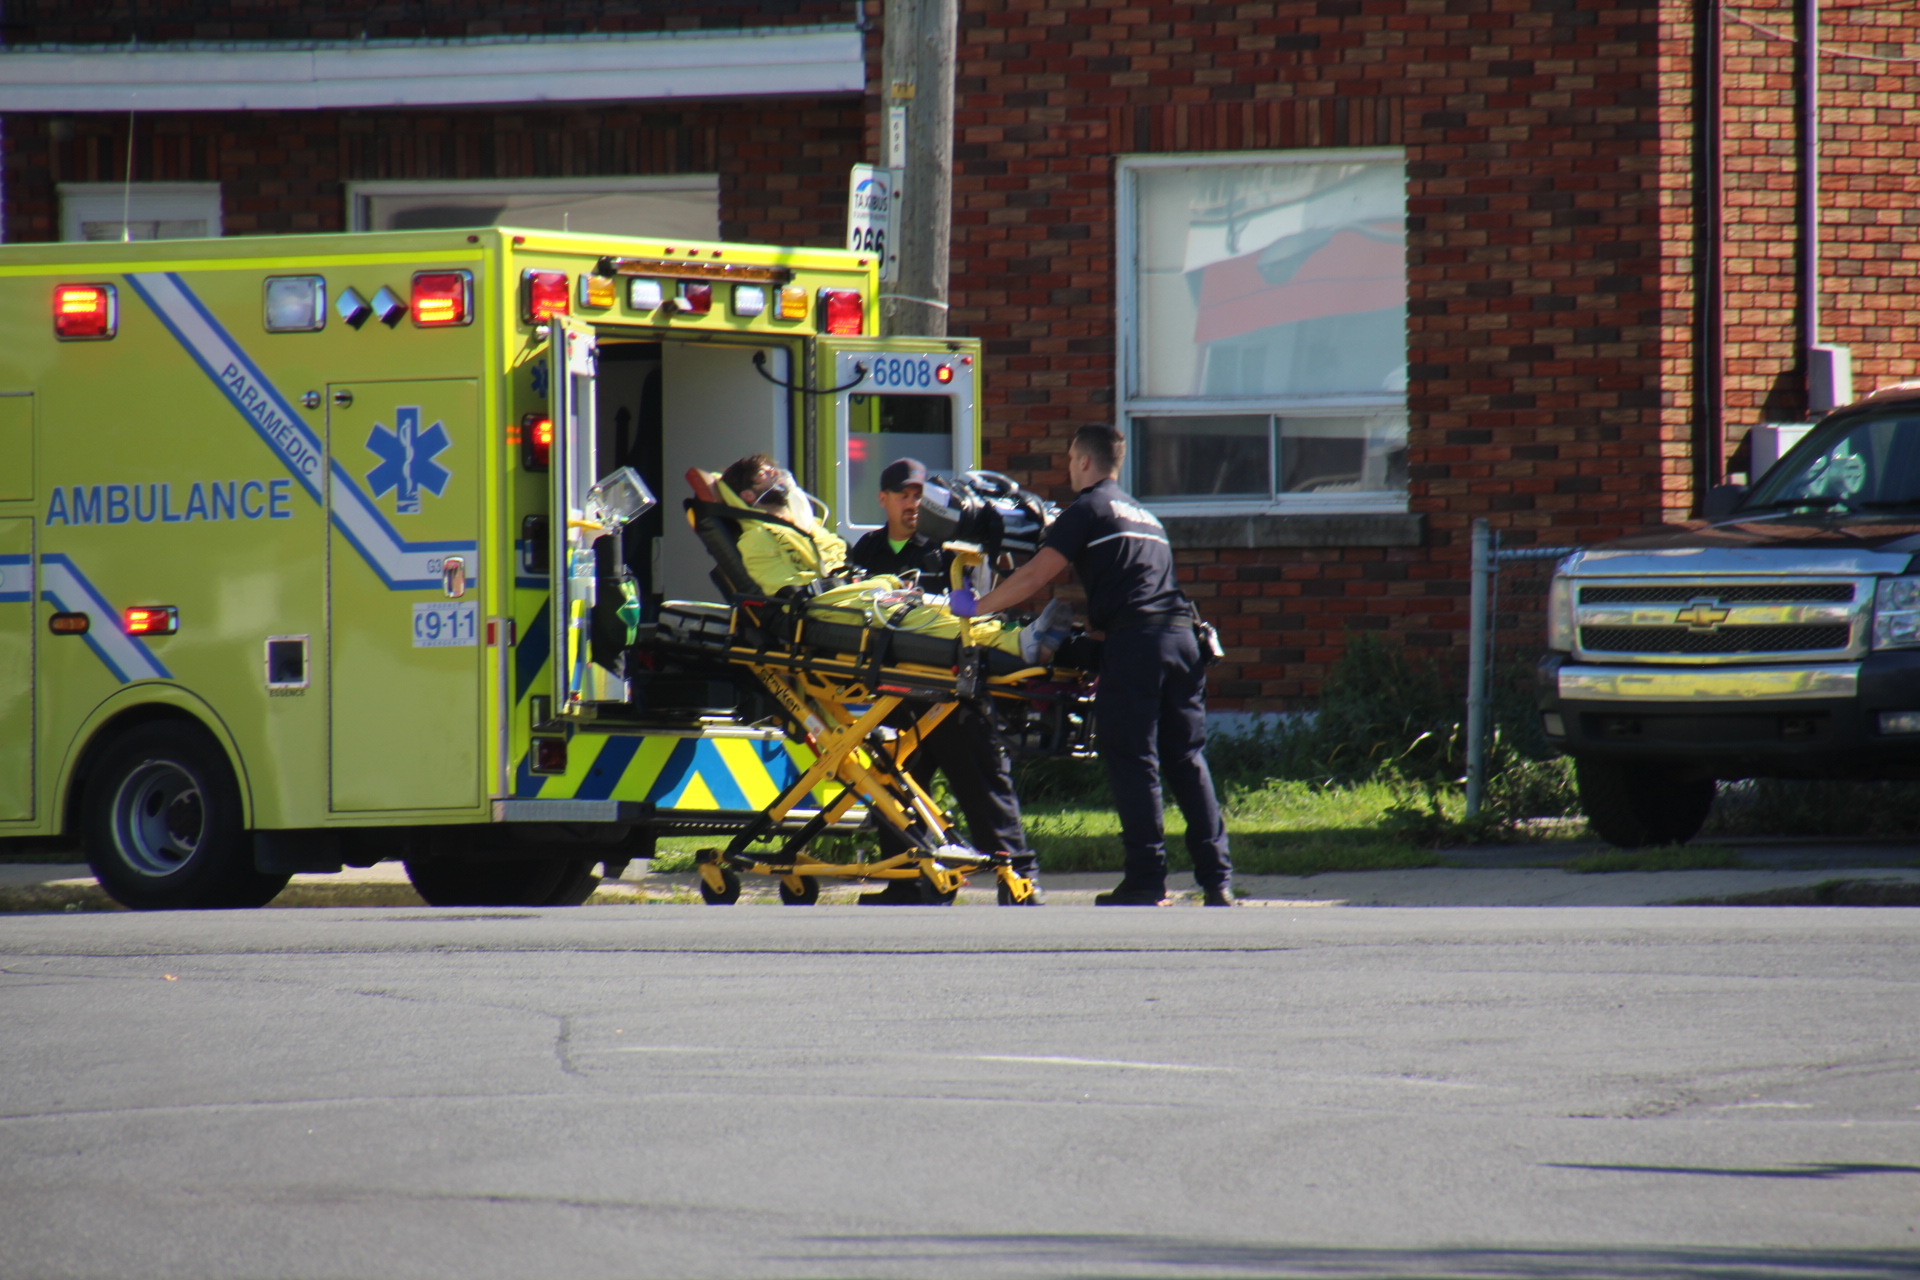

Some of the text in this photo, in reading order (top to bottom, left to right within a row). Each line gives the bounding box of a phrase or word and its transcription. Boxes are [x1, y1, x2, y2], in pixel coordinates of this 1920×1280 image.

[854, 193, 888, 212] TAXIBUS
[853, 227, 885, 269] 266
[874, 358, 931, 388] 6808
[221, 362, 318, 475] PARAMÉDIC
[45, 479, 292, 527] AMBULANCE
[761, 669, 801, 713] stryker
